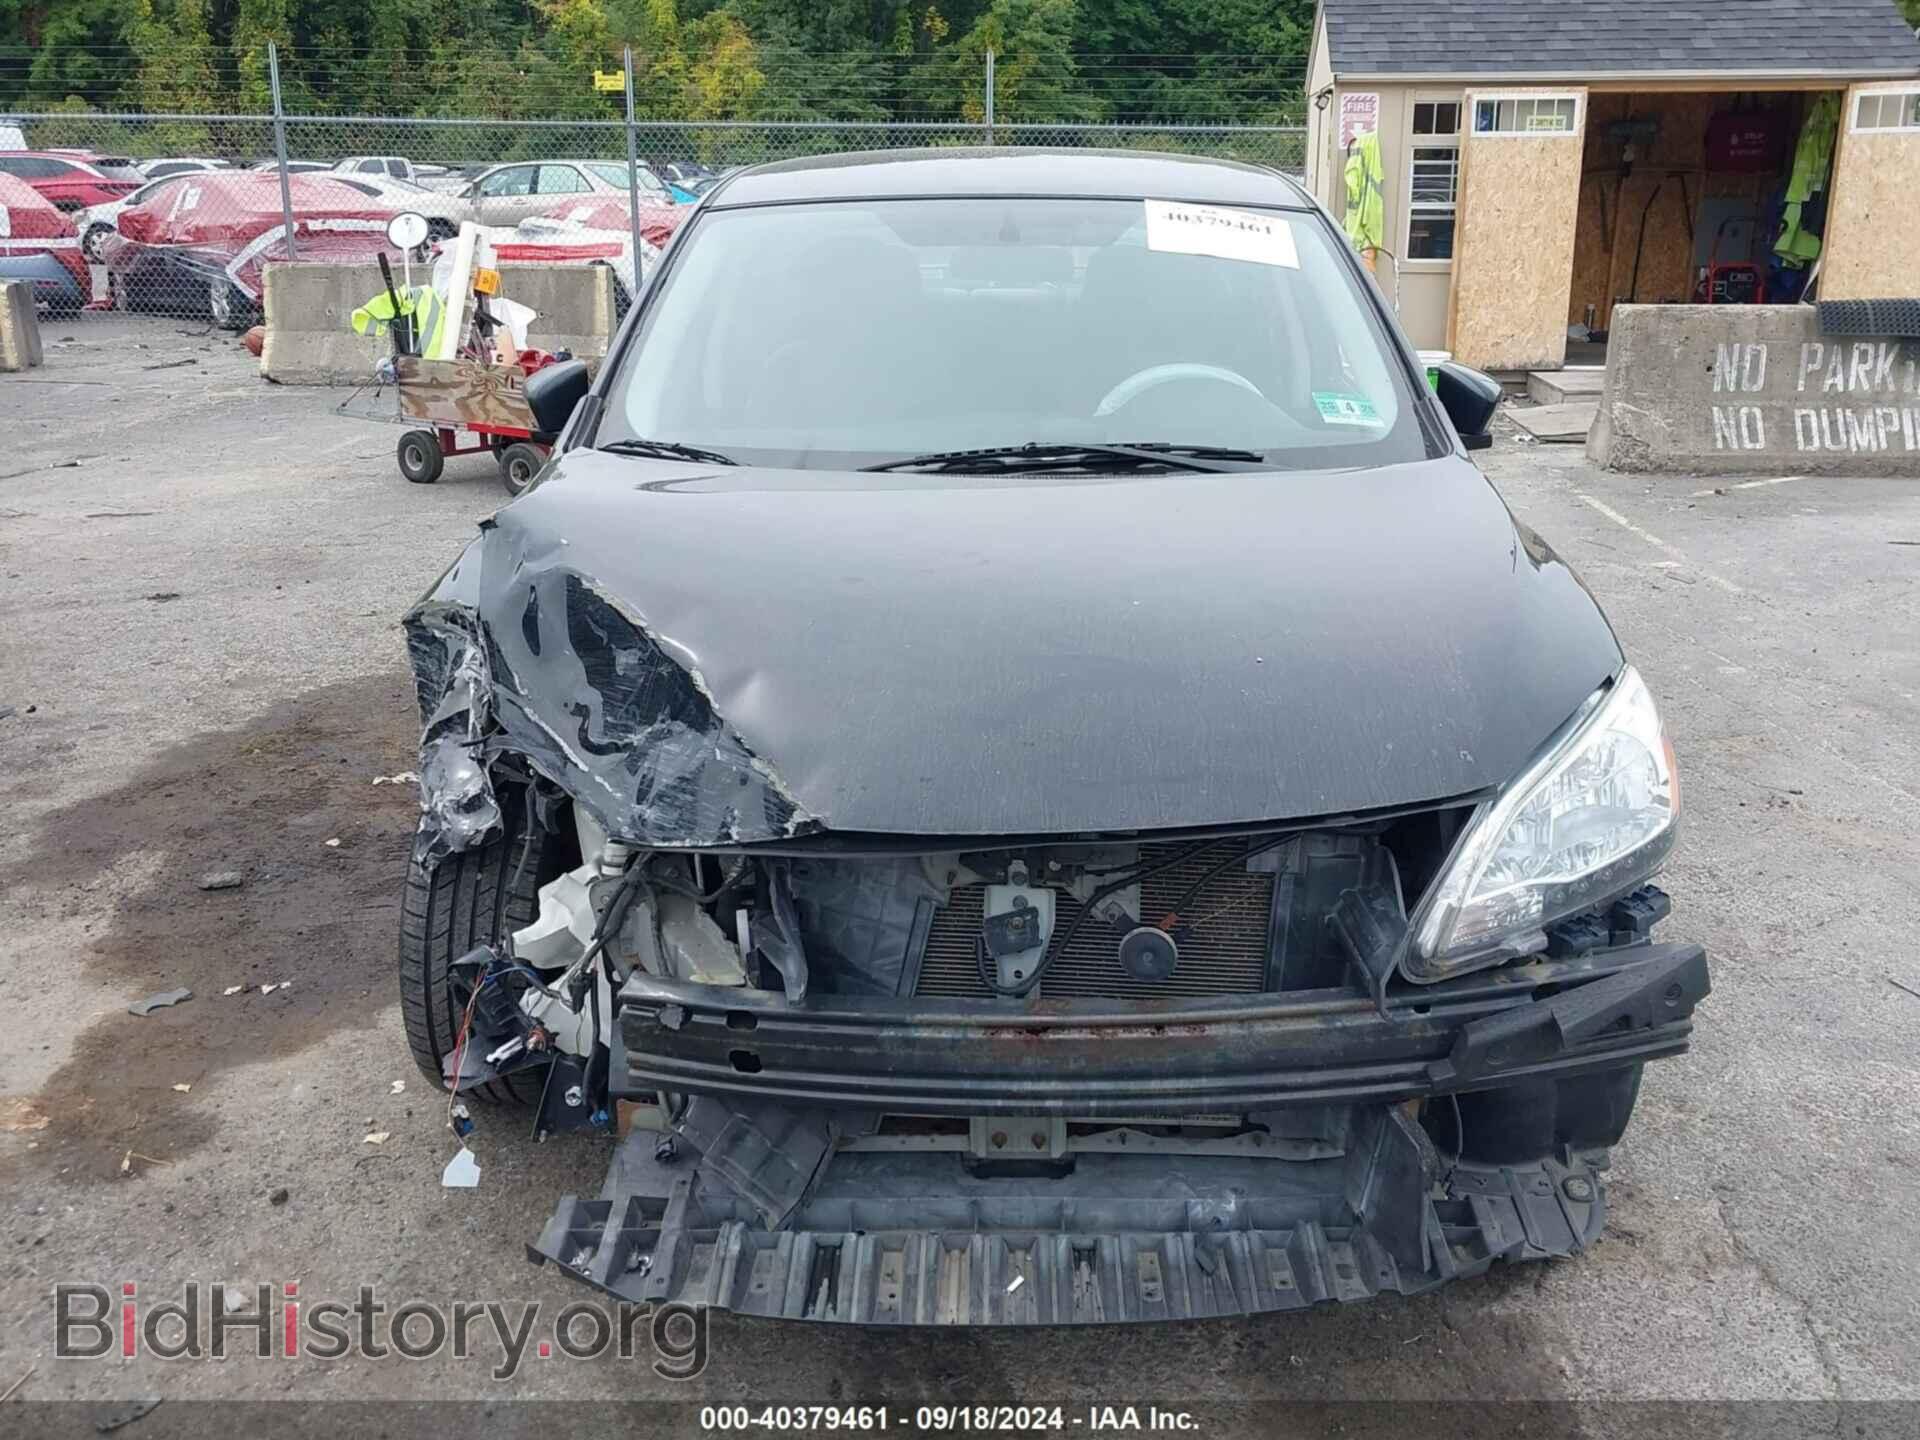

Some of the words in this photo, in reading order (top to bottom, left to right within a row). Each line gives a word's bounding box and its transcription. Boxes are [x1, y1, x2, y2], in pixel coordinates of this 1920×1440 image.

[1347, 102, 1374, 112] FIRE
[1713, 344, 1767, 392] NO
[1712, 407, 1765, 450] NO
